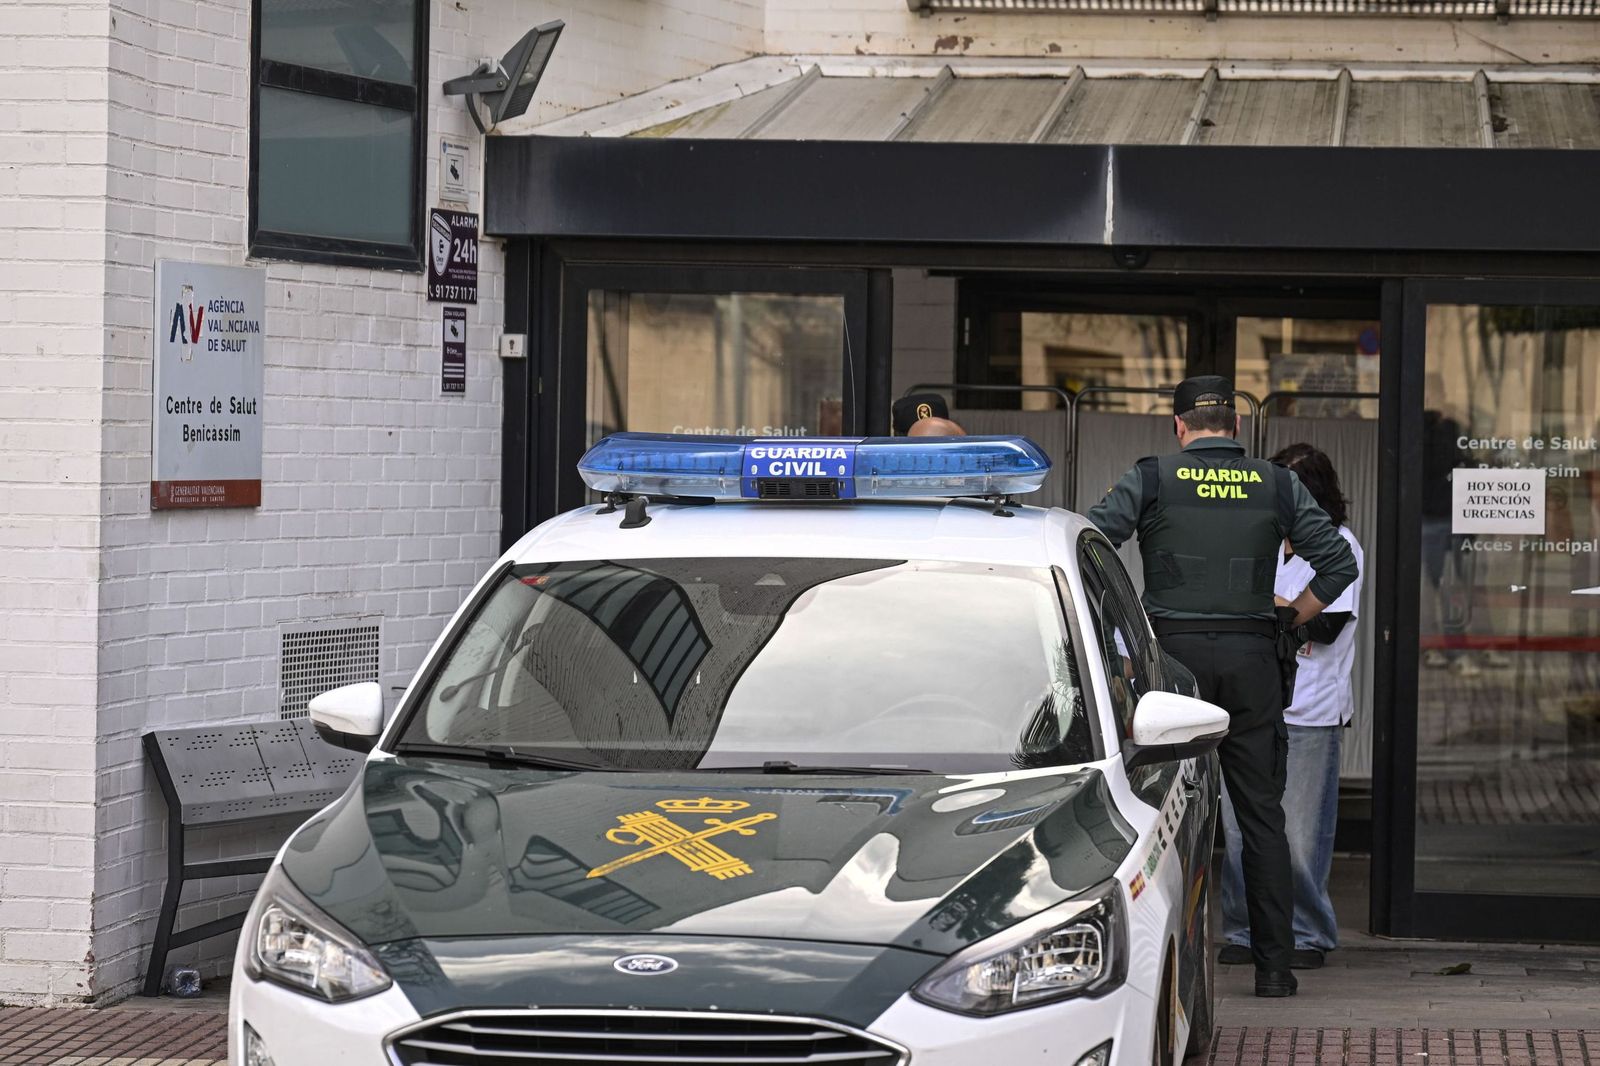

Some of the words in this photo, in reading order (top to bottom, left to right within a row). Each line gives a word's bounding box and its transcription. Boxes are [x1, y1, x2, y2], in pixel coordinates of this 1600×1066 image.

[451, 215, 478, 229] ALARMA
[453, 238, 477, 264] 24h
[436, 284, 444, 298] 91
[446, 285, 458, 299] 737
[461, 286, 467, 300] 11
[469, 288, 476, 300] 71
[208, 296, 245, 314] AGÈNCIA
[208, 320, 260, 334] VALNCIANA
[208, 339, 218, 352] DE
[220, 340, 246, 352] SALUT
[166, 396, 202, 414] Centre
[210, 396, 222, 414] de
[230, 396, 256, 415] Salut
[183, 424, 240, 442] Benicàssim
[1456, 436, 1516, 450] Centre
[1522, 436, 1544, 450] de
[1550, 437, 1598, 450] Salut
[751, 447, 847, 459] GUARDIA
[769, 462, 826, 476] CIVIL
[1176, 468, 1262, 482] GUARDIA
[1197, 484, 1248, 498] CIVIL
[1468, 482, 1494, 492] HOY
[1497, 482, 1530, 492] SOLO
[1467, 494, 1531, 505] ATENCIÓN
[1463, 510, 1534, 519] URGENCIAS
[1519, 538, 1598, 554] Principal
